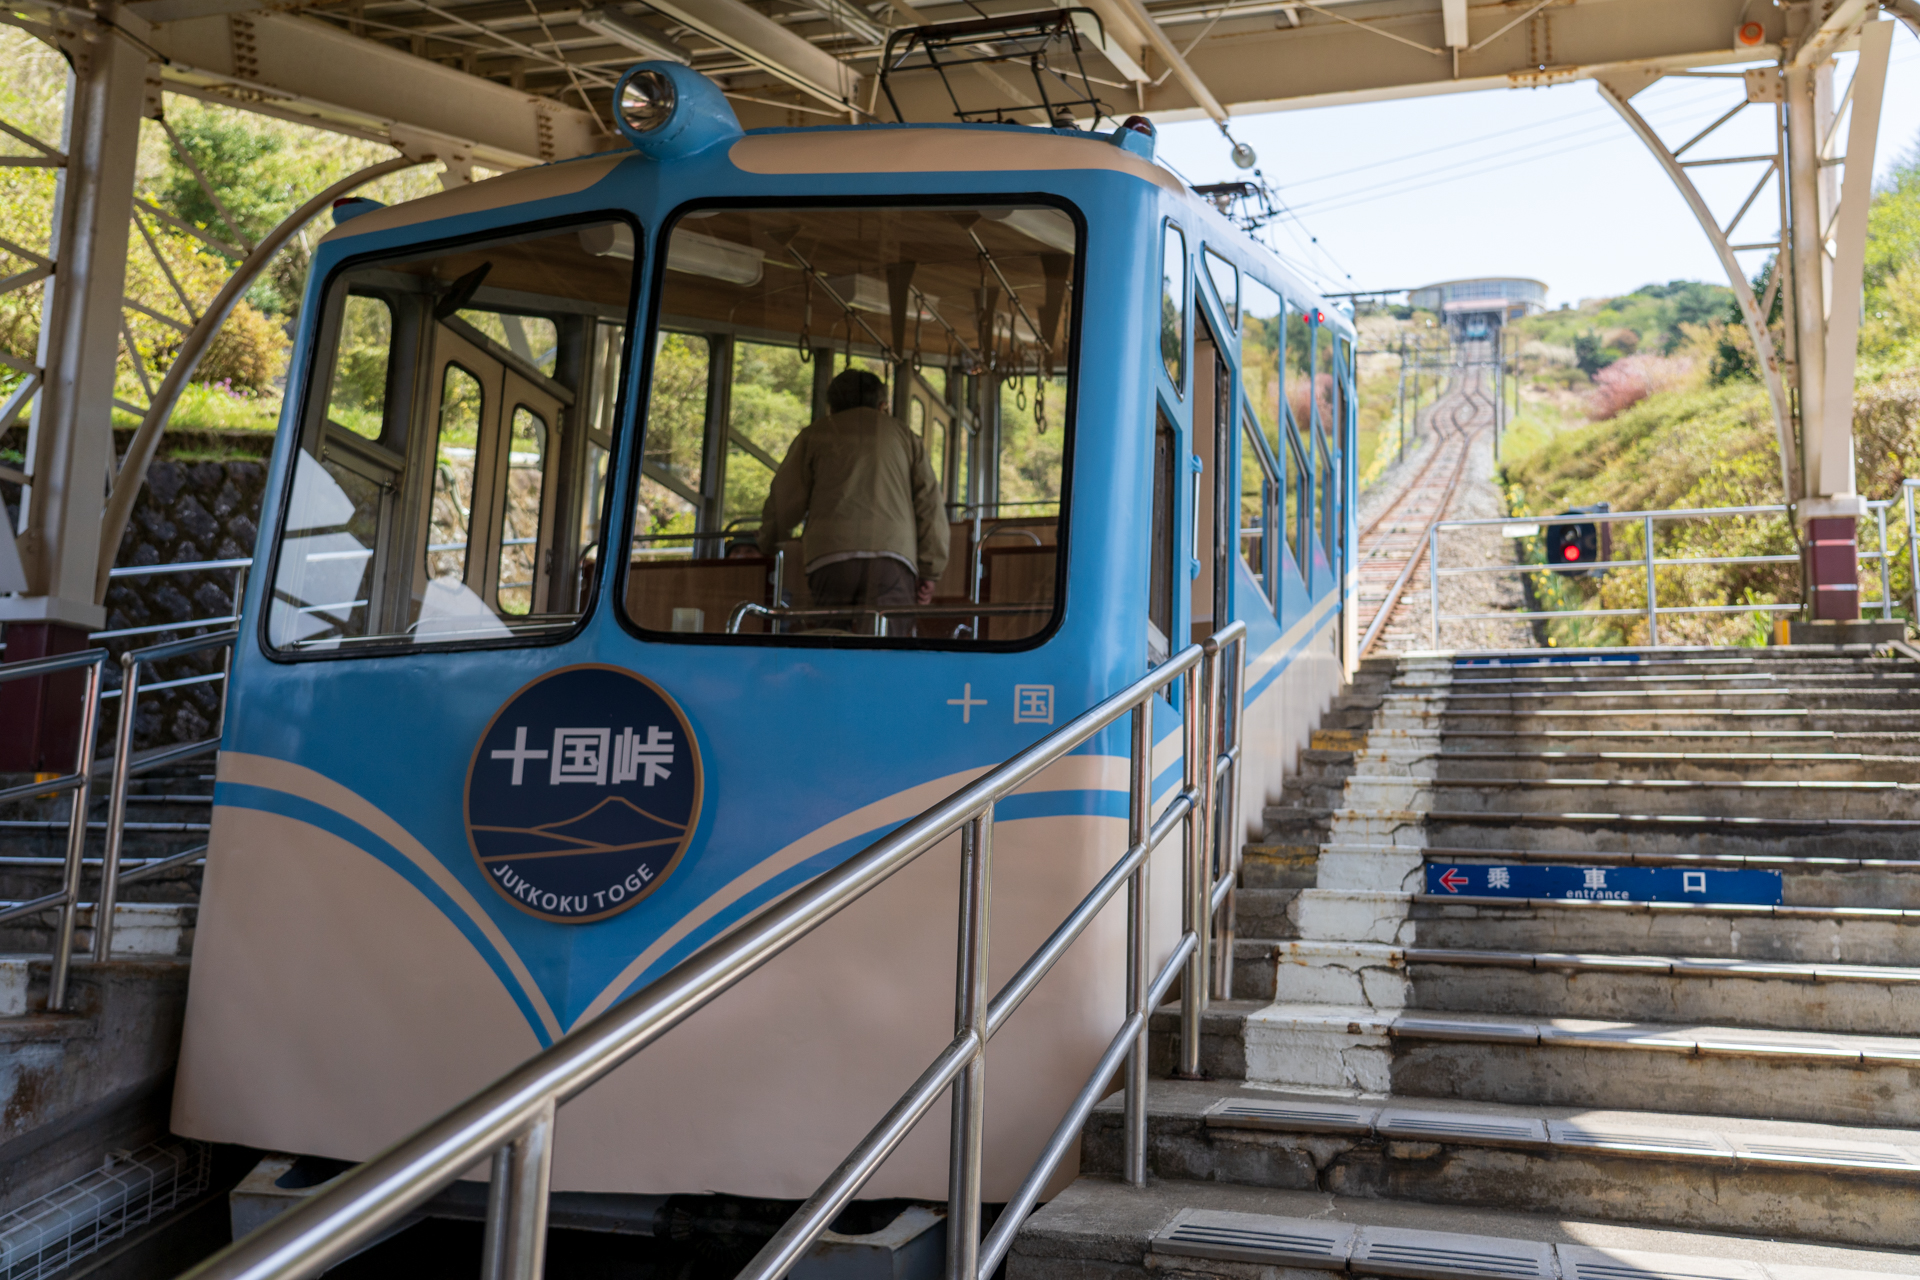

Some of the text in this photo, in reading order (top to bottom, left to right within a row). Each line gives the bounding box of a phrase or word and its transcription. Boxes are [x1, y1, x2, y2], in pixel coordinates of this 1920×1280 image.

[490, 725, 675, 786] 十国峠
[493, 862, 654, 912] JUKKOKU TOGE
[1566, 889, 1630, 900] entrance
